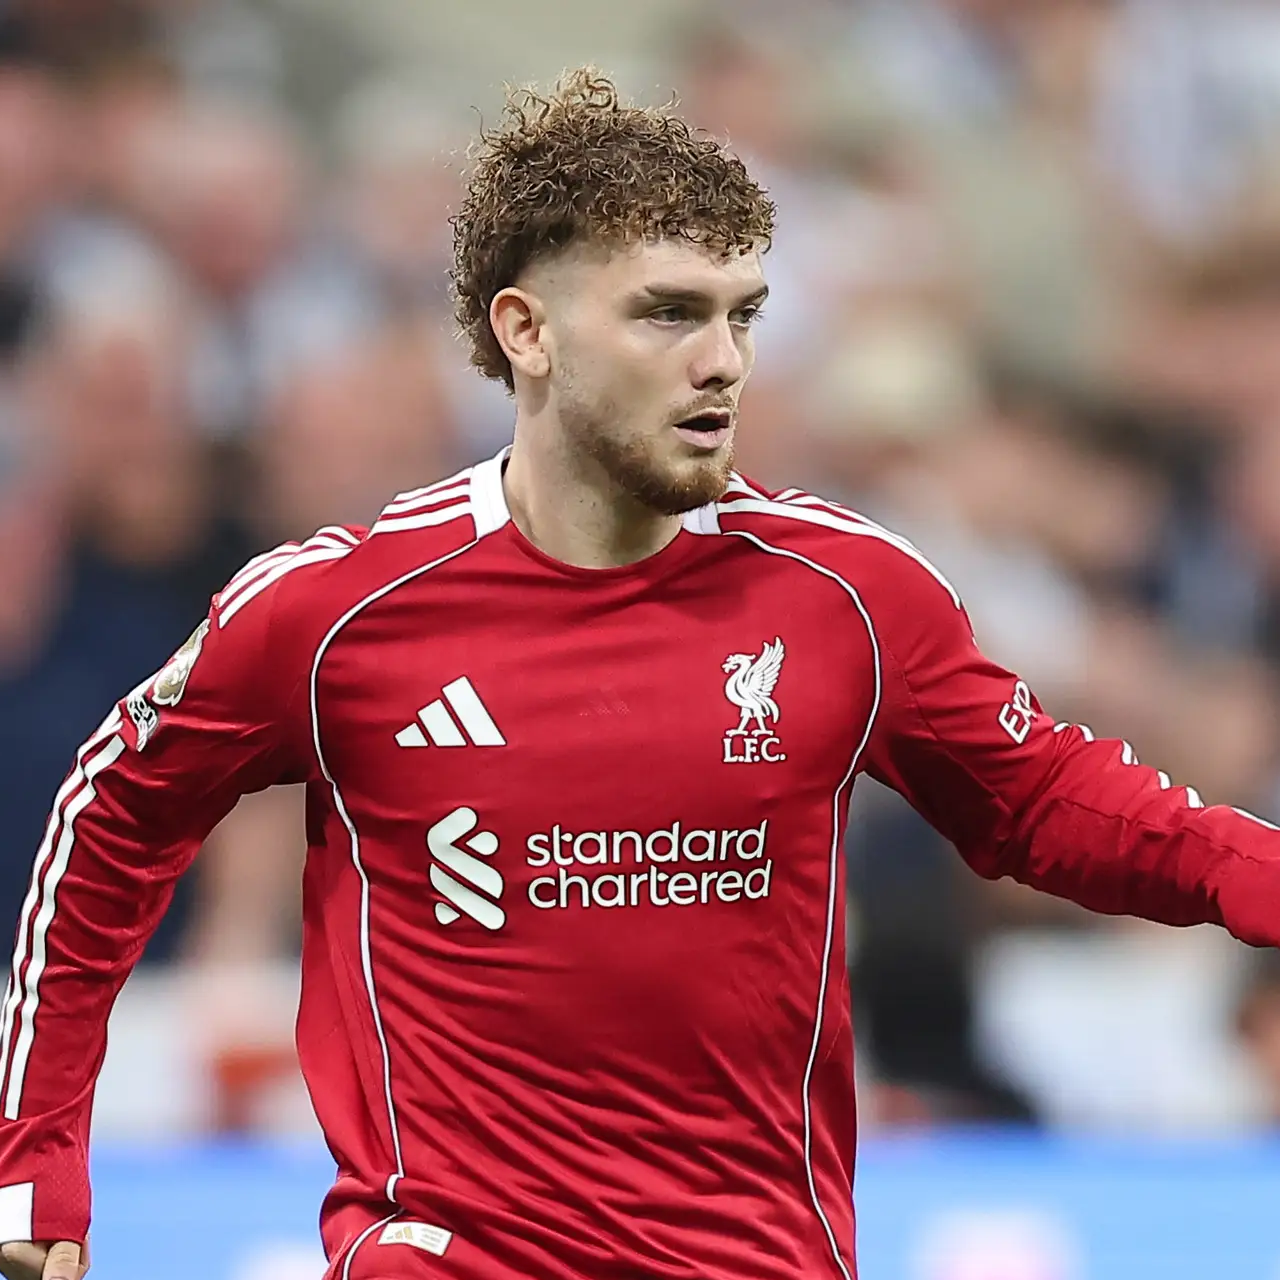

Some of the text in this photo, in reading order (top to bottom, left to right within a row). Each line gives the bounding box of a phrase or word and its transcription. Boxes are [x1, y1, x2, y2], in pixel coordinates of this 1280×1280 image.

[723, 738, 786, 763] L.F.C.
[526, 819, 768, 867] standard
[527, 859, 772, 909] chartered
